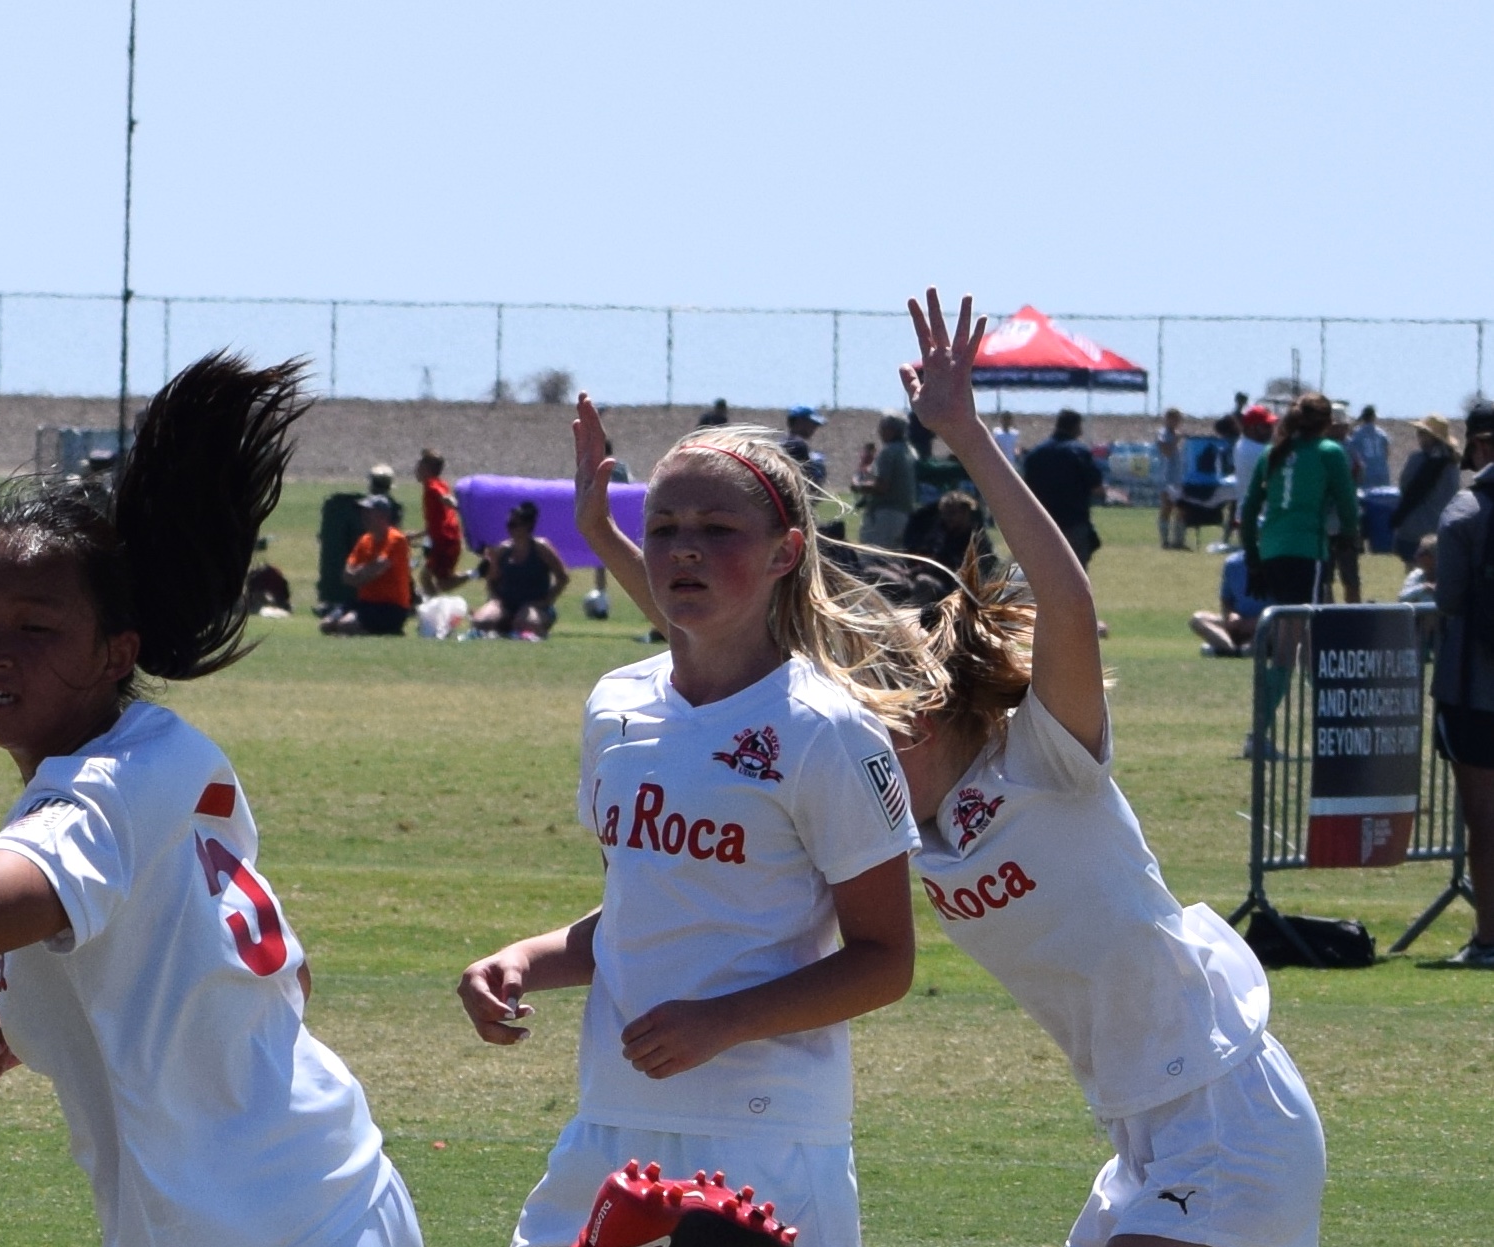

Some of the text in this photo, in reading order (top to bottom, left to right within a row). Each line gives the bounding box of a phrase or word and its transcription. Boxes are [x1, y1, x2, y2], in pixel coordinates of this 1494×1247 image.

[1318, 649, 1383, 678] ACADEMY
[1317, 688, 1347, 717] AND
[1317, 726, 1371, 757] BEYOND
[626, 782, 747, 865] Roca
[921, 860, 1037, 921] Roca
